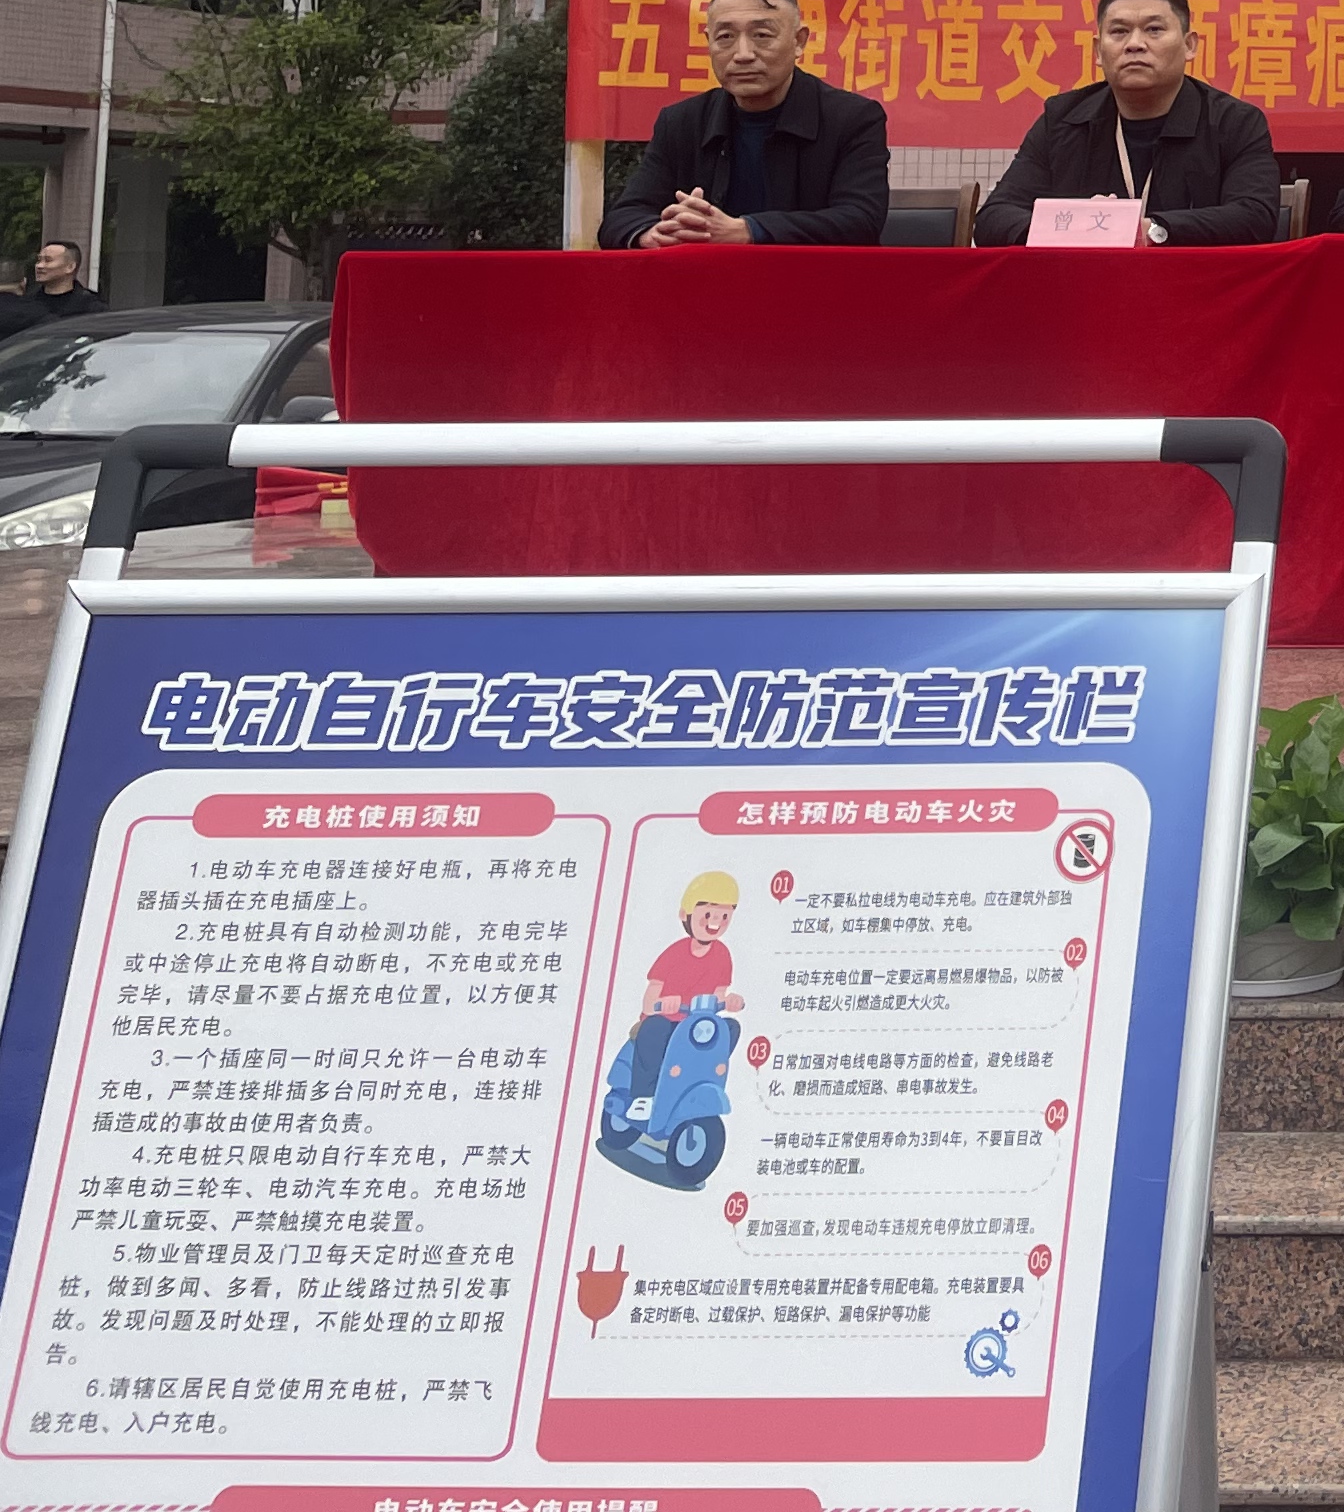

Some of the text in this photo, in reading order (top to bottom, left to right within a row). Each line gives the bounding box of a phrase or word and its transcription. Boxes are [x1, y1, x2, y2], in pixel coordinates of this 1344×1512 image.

[1053, 209, 1112, 234] 曾文
[139, 668, 1150, 754] 电动自行车安全防范宣传栏
[262, 802, 483, 830] 充电桩使用须知
[733, 797, 1018, 827] 怎样预防电动车火灾
